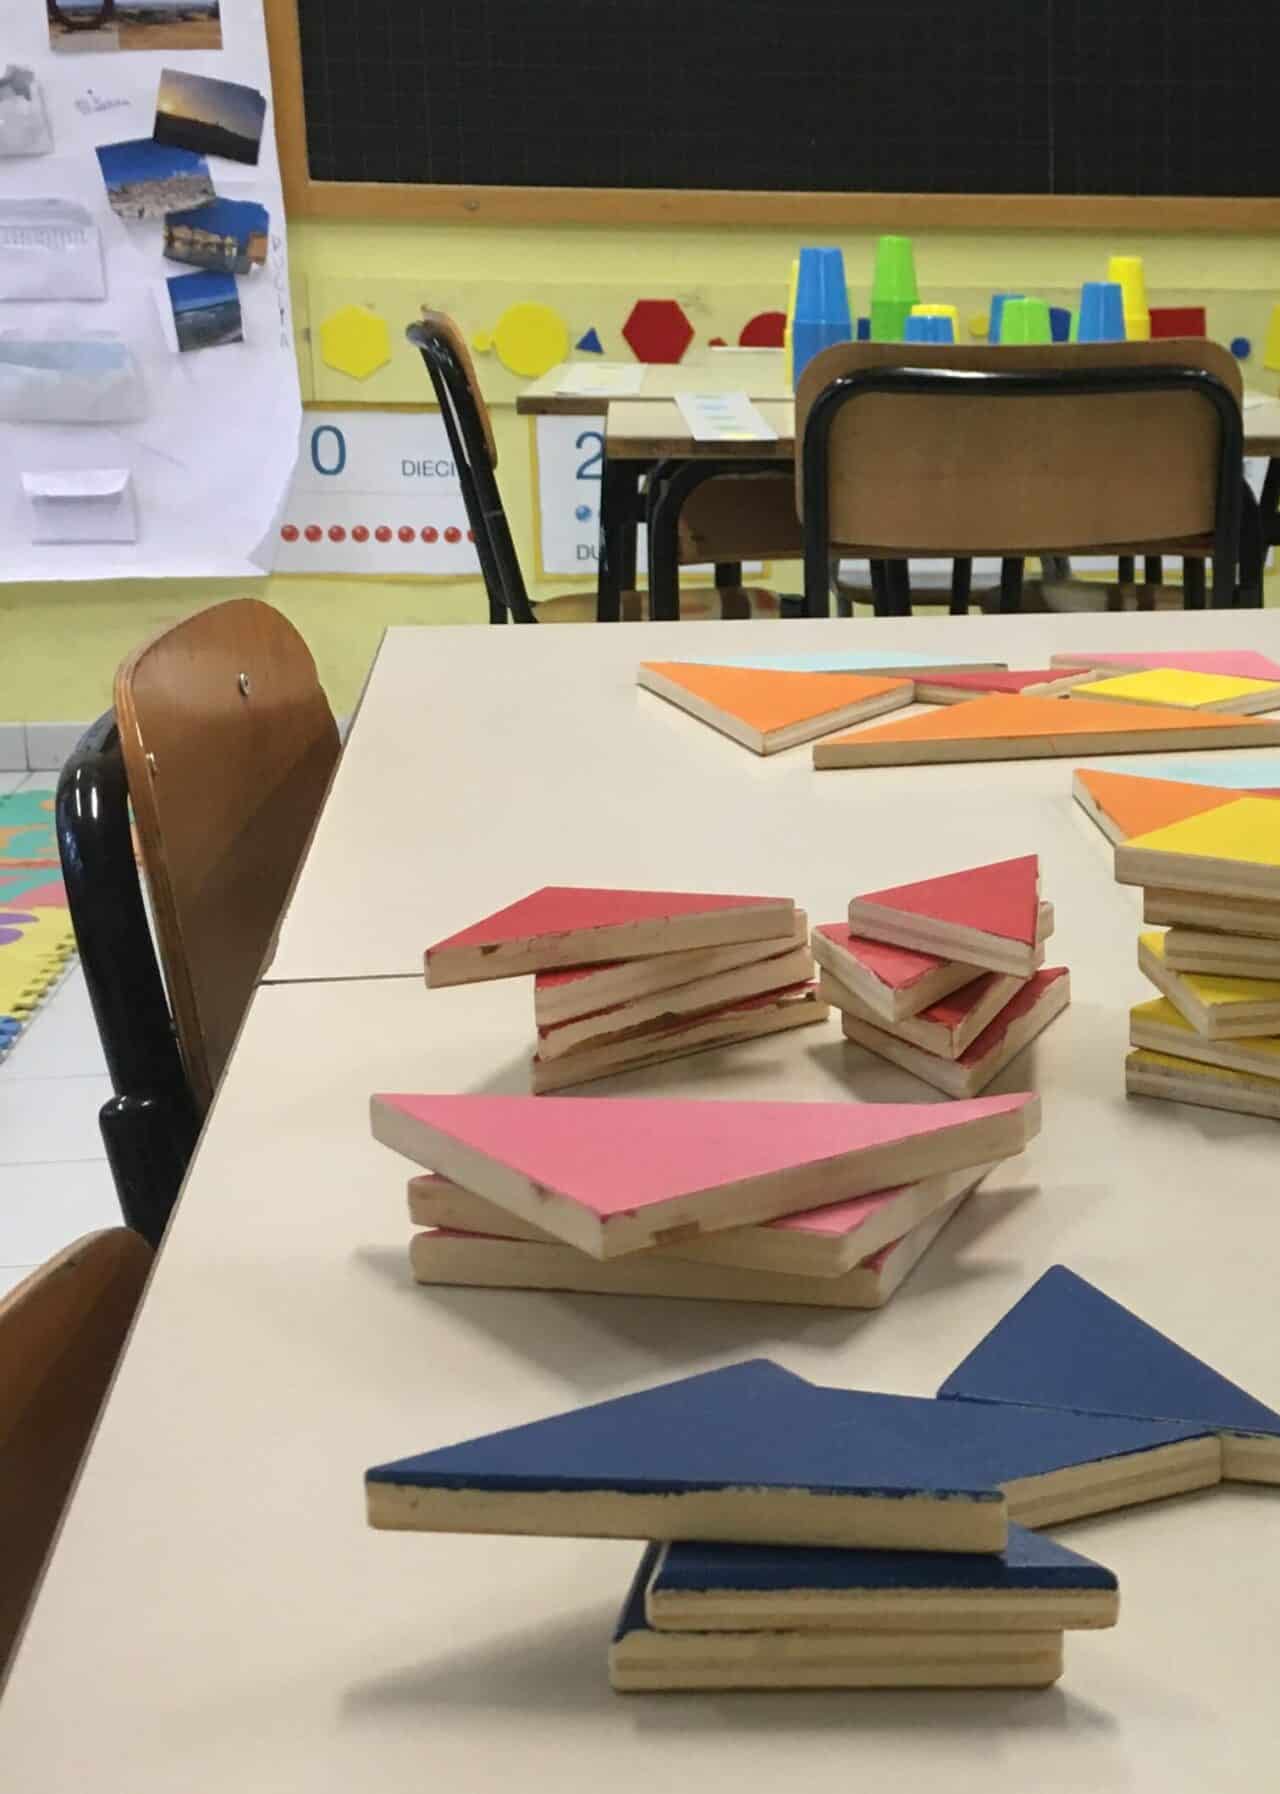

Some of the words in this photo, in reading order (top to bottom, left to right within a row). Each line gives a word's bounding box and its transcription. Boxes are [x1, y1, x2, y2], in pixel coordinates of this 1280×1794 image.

[311, 424, 346, 476] 0
[576, 431, 604, 480] 2
[401, 459, 455, 478] DIECI
[576, 543, 601, 562] DU
